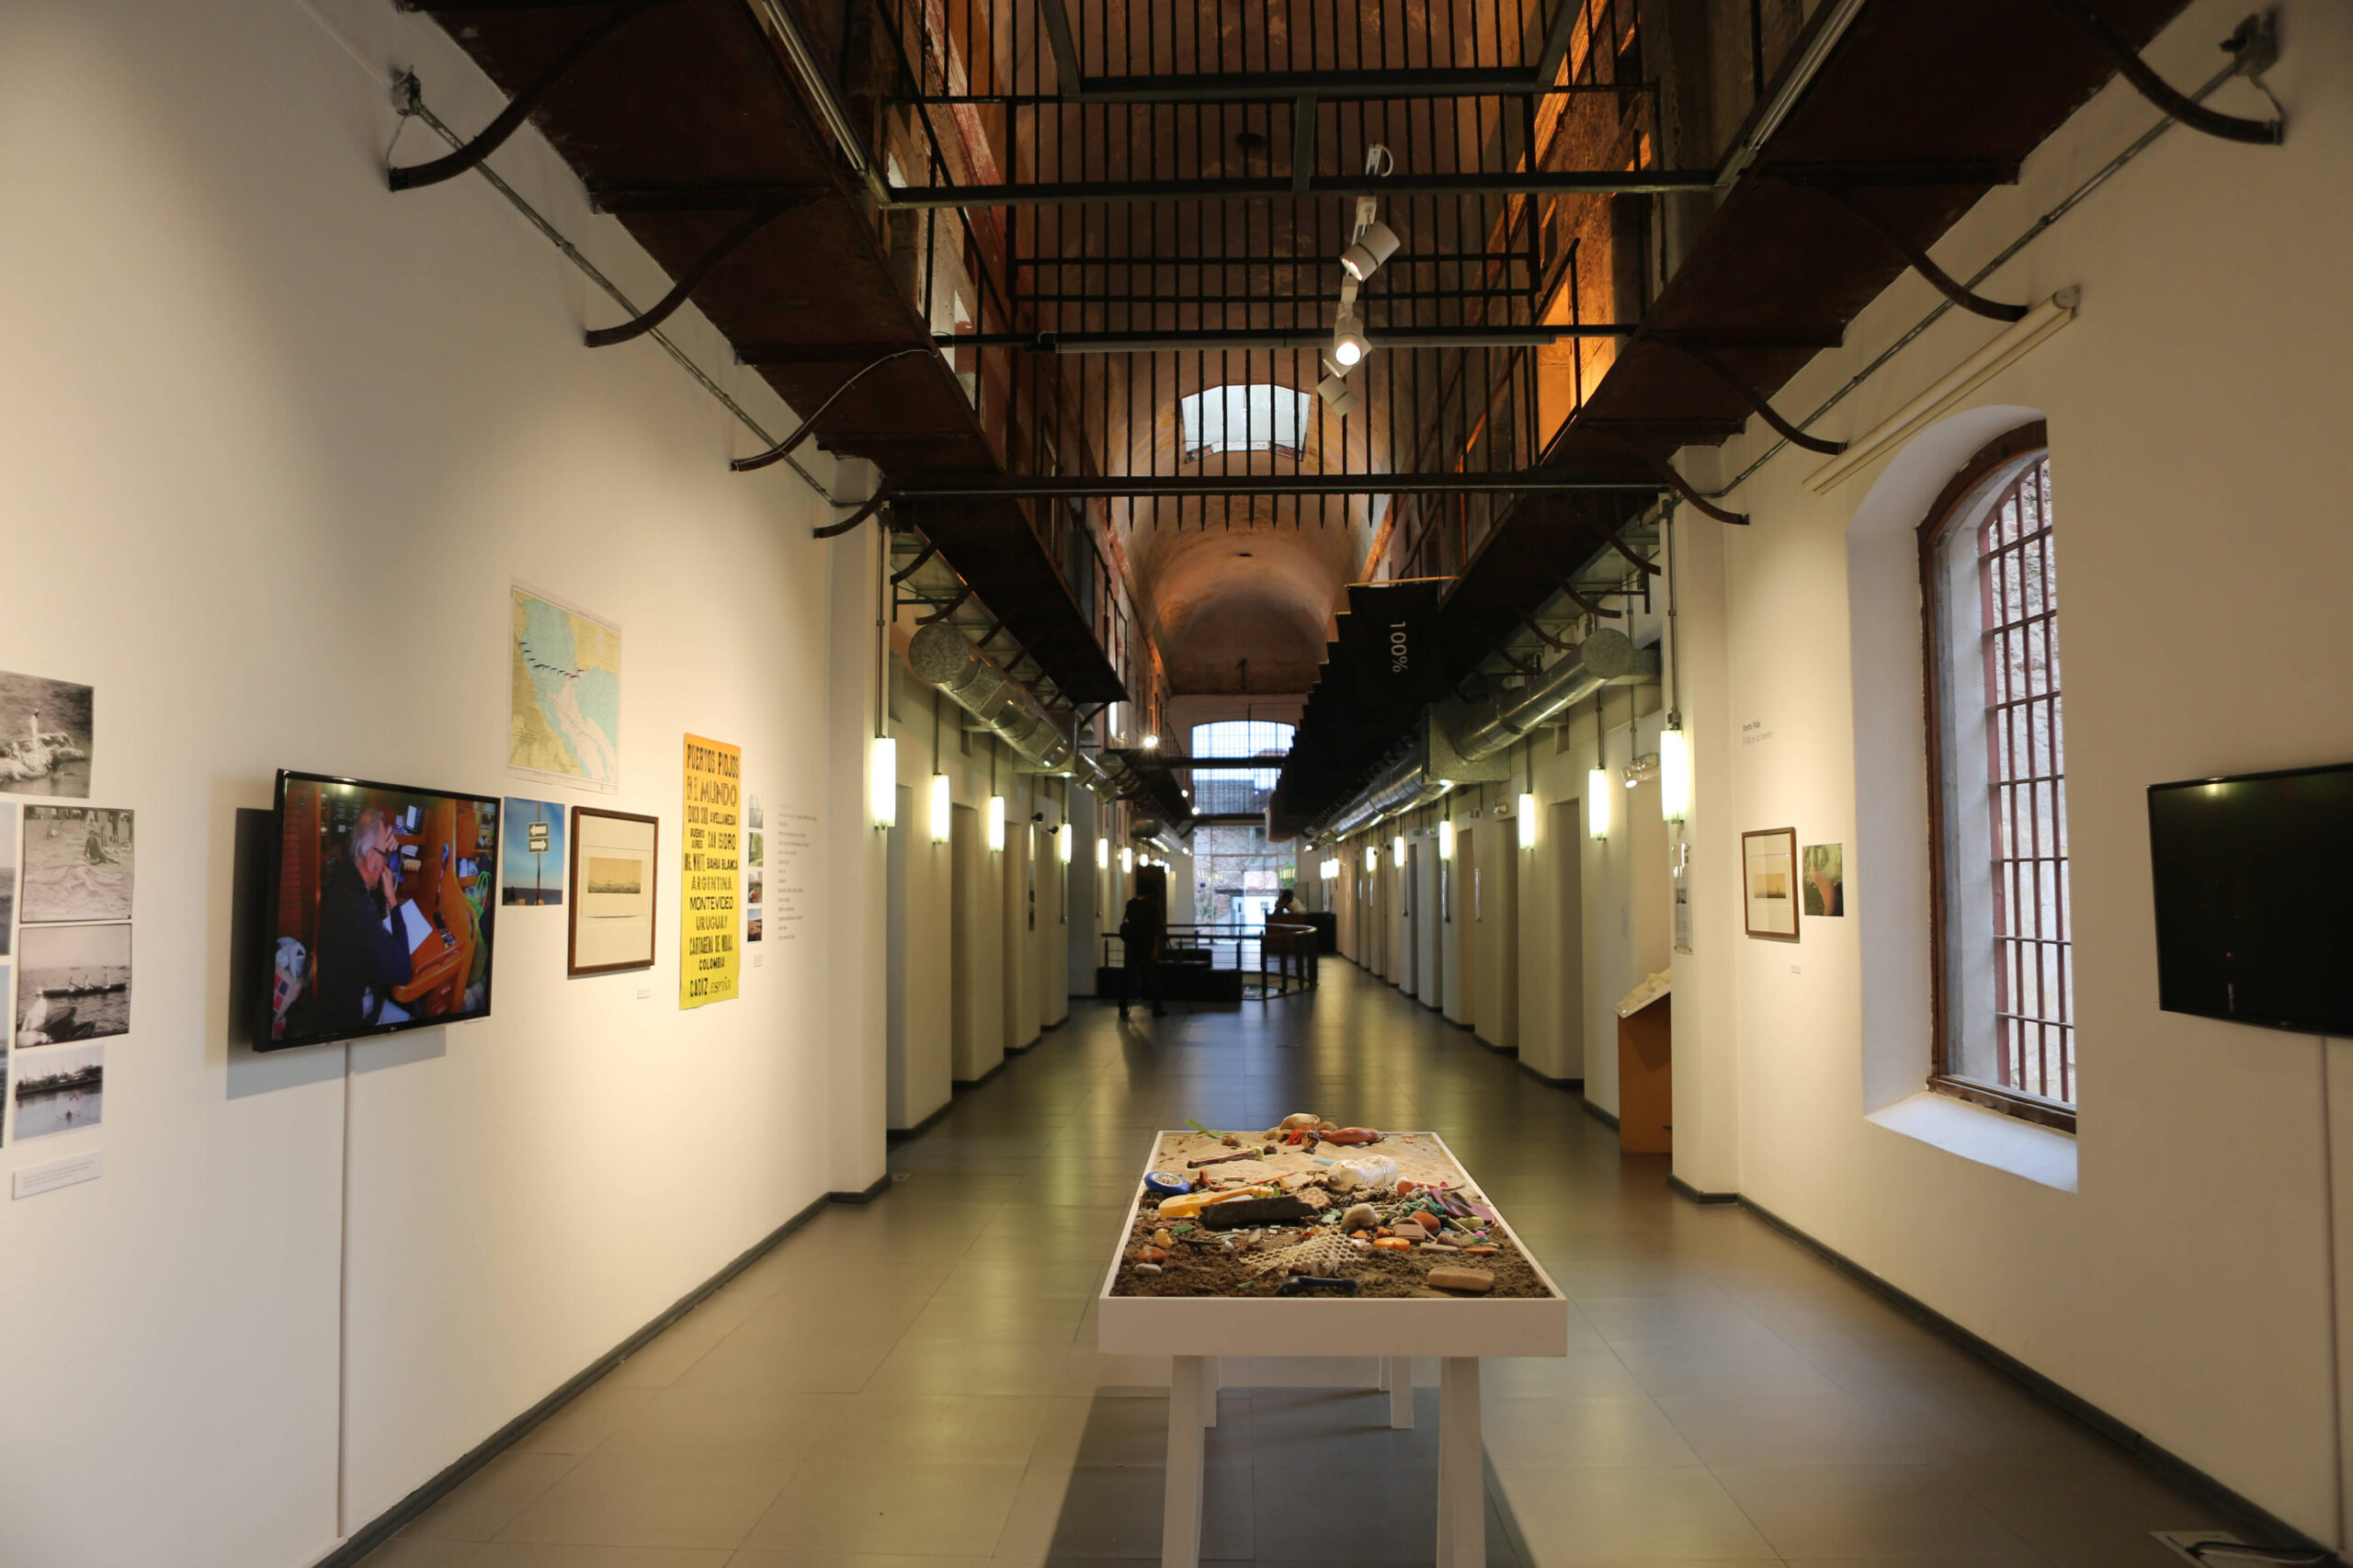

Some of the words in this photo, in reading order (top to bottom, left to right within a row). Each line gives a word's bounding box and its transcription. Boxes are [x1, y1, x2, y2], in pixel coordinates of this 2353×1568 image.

[1390, 620, 1408, 673] 100%
[687, 744, 715, 774] PUERTOS
[718, 752, 739, 778] PIOJOS
[699, 779, 737, 807] MUNDO
[710, 812, 736, 826] AVELLANEDA
[690, 827, 705, 838] BUENOS
[708, 831, 716, 848] SAN
[718, 832, 736, 850] ISIDRO
[691, 839, 703, 848] AIRES
[722, 858, 738, 870] BLANCA
[691, 875, 733, 891] ARGENTINA
[689, 896, 733, 911] MONTEVIDEO
[696, 915, 728, 931] URUGUAY
[689, 936, 713, 956] CARTAGENA
[715, 935, 721, 953] DE
[699, 956, 725, 971] COLOMBIA
[689, 978, 709, 998] CADIZ
[710, 976, 732, 994] ESPAÑA
